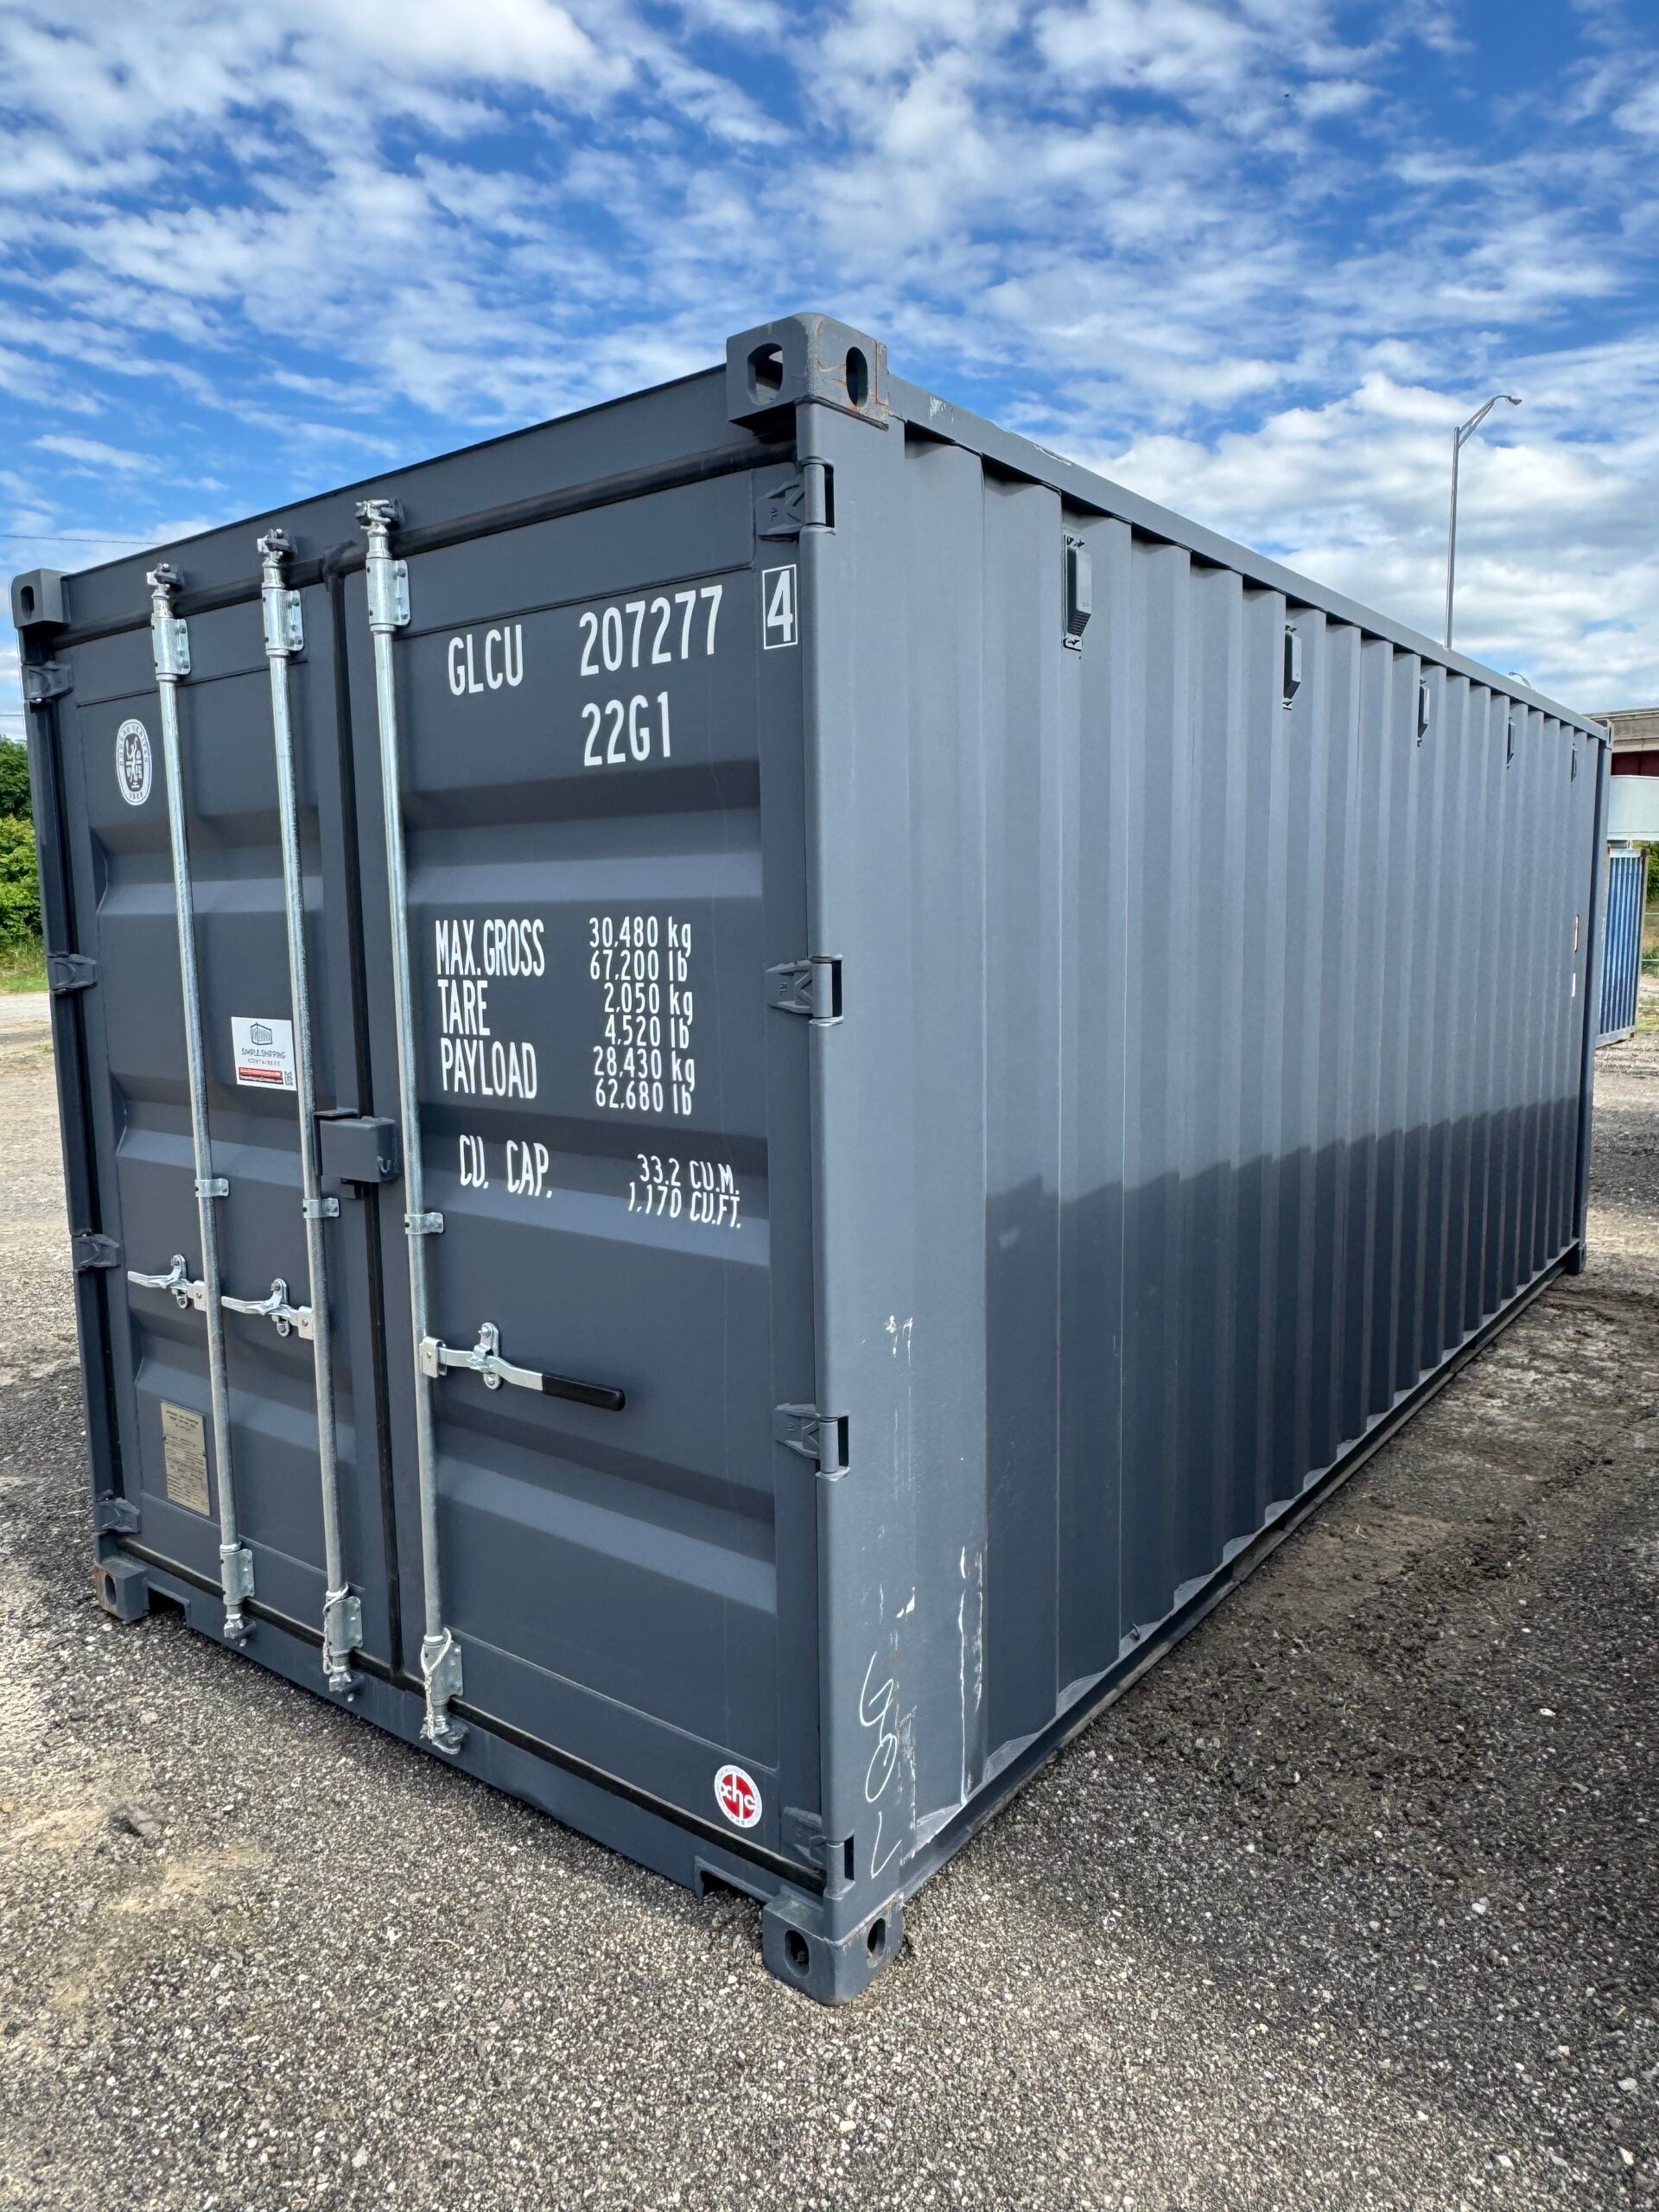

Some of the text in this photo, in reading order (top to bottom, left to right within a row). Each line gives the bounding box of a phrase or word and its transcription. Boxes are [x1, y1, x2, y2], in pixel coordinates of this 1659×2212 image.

[448, 570, 794, 696] GLCU 207277 4
[582, 691, 671, 766] 22G1
[589, 916, 658, 948] 30,480
[668, 917, 691, 957] kg
[590, 950, 688, 982] 67,200 lb
[437, 979, 693, 1036] TARE 2,050 kg
[605, 1014, 690, 1049] 4,520 lb
[441, 1038, 695, 1099] PAYLOAD 28,430 kg
[595, 1078, 691, 1116] 62,680 lb
[459, 1135, 740, 1198] CU. CAP. 33.2 CU.M.
[690, 1192, 741, 1228] CU.FT.
